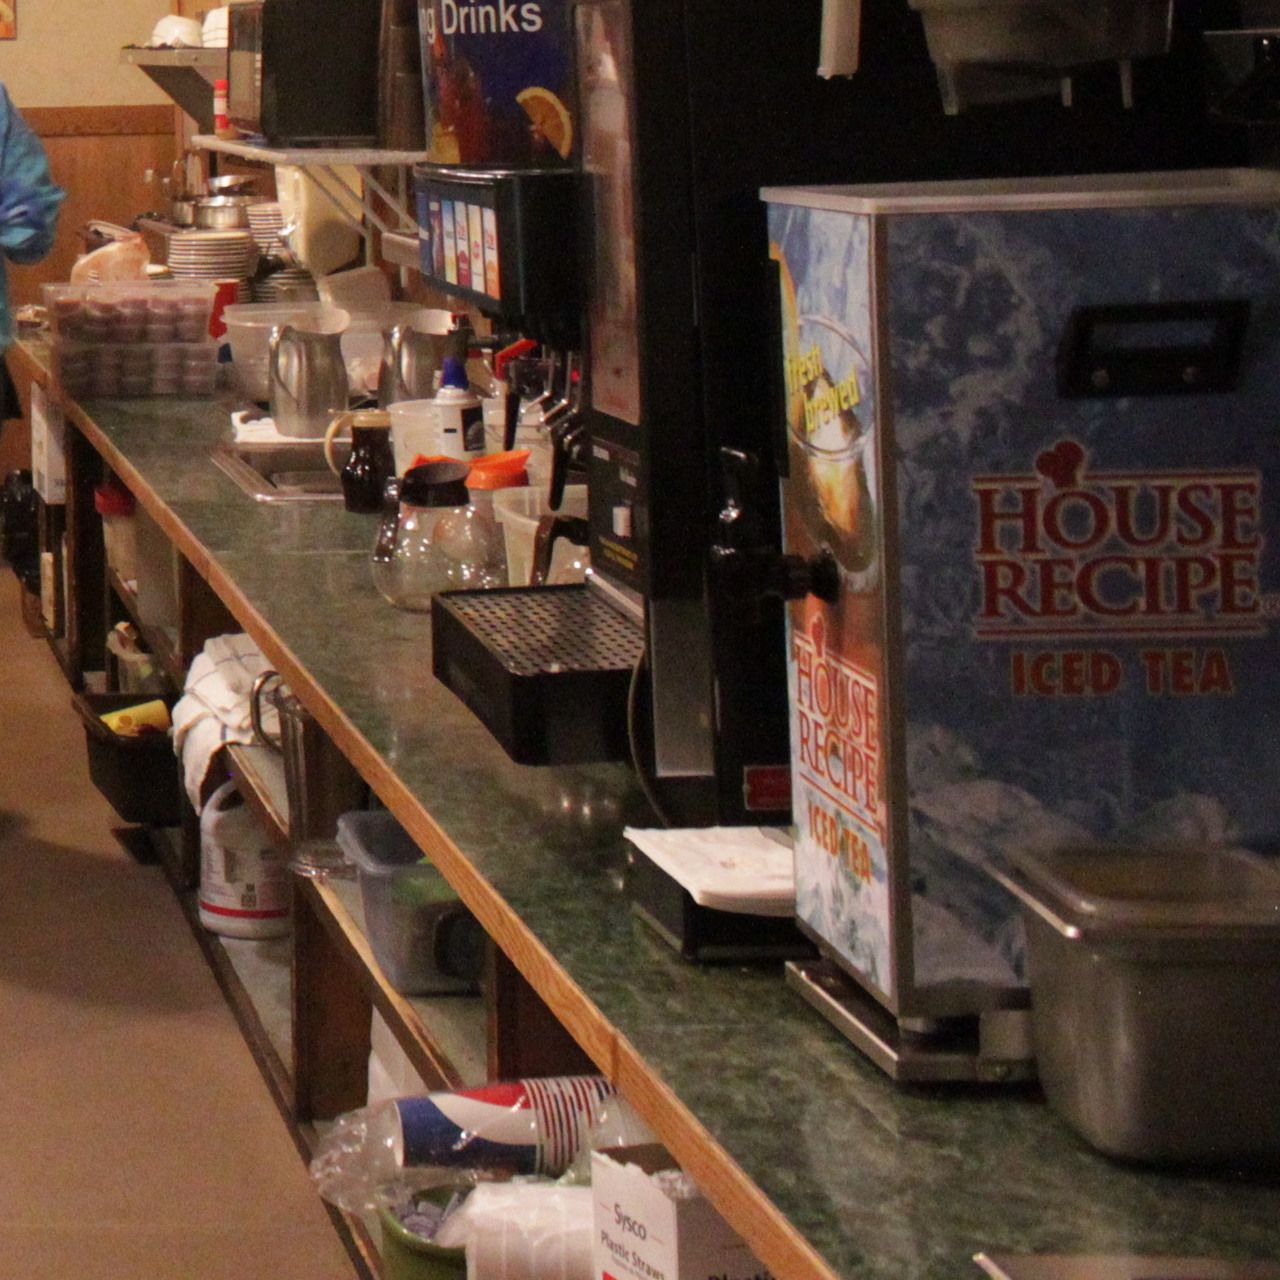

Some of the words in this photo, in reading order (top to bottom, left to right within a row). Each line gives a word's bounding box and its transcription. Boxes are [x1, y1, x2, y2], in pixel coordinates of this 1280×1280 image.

[975, 481, 1262, 555] HOUSE
[978, 553, 1261, 618] RECIPE
[795, 642, 878, 753] HOUSE
[1011, 650, 1123, 696] ICED
[1142, 649, 1233, 696] TEA
[799, 709, 878, 815] RECIPE
[808, 801, 839, 857] ICED
[843, 826, 872, 886] TEA
[601, 1230, 630, 1263] Plastic
[614, 1202, 647, 1241] Sysco
